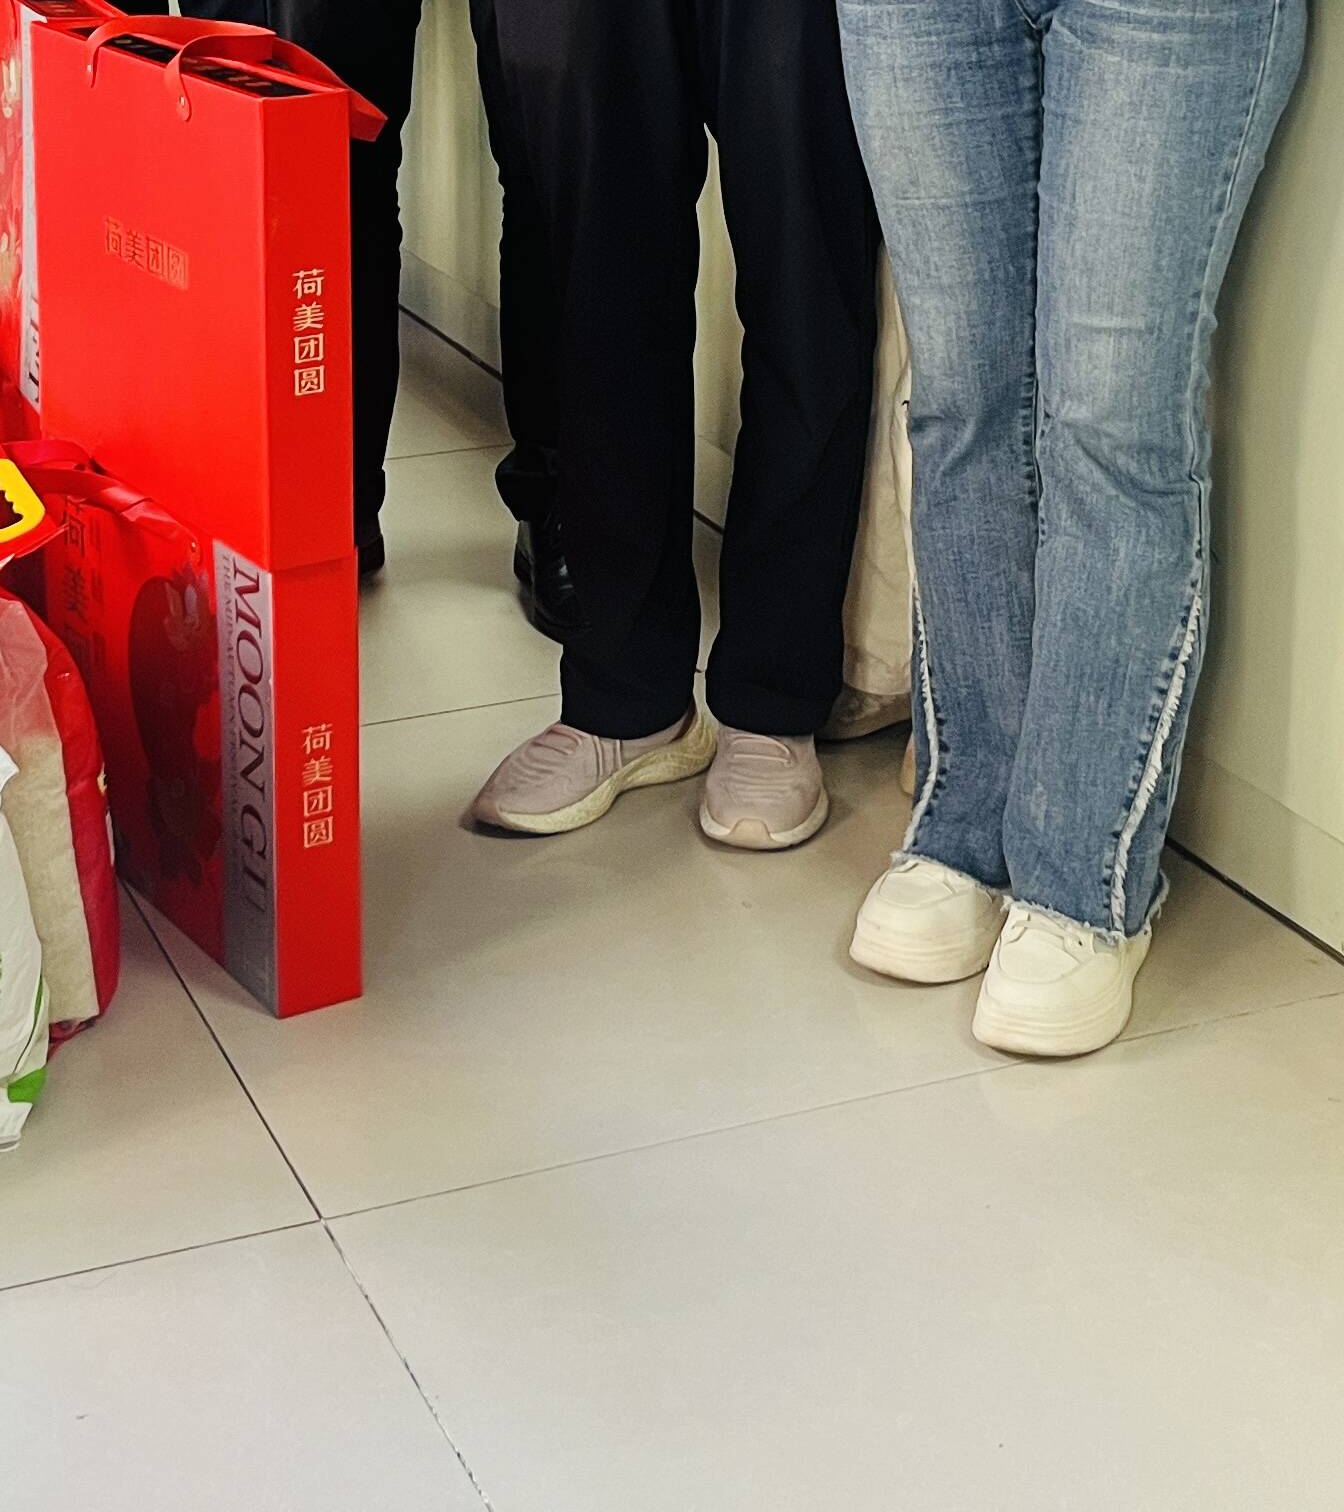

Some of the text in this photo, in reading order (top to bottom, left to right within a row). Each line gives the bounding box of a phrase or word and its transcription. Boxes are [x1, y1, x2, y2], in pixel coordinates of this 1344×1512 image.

[292, 269, 325, 396] 荷美团圆
[233, 556, 266, 802] MOON
[301, 722, 334, 849] 荷美团圆
